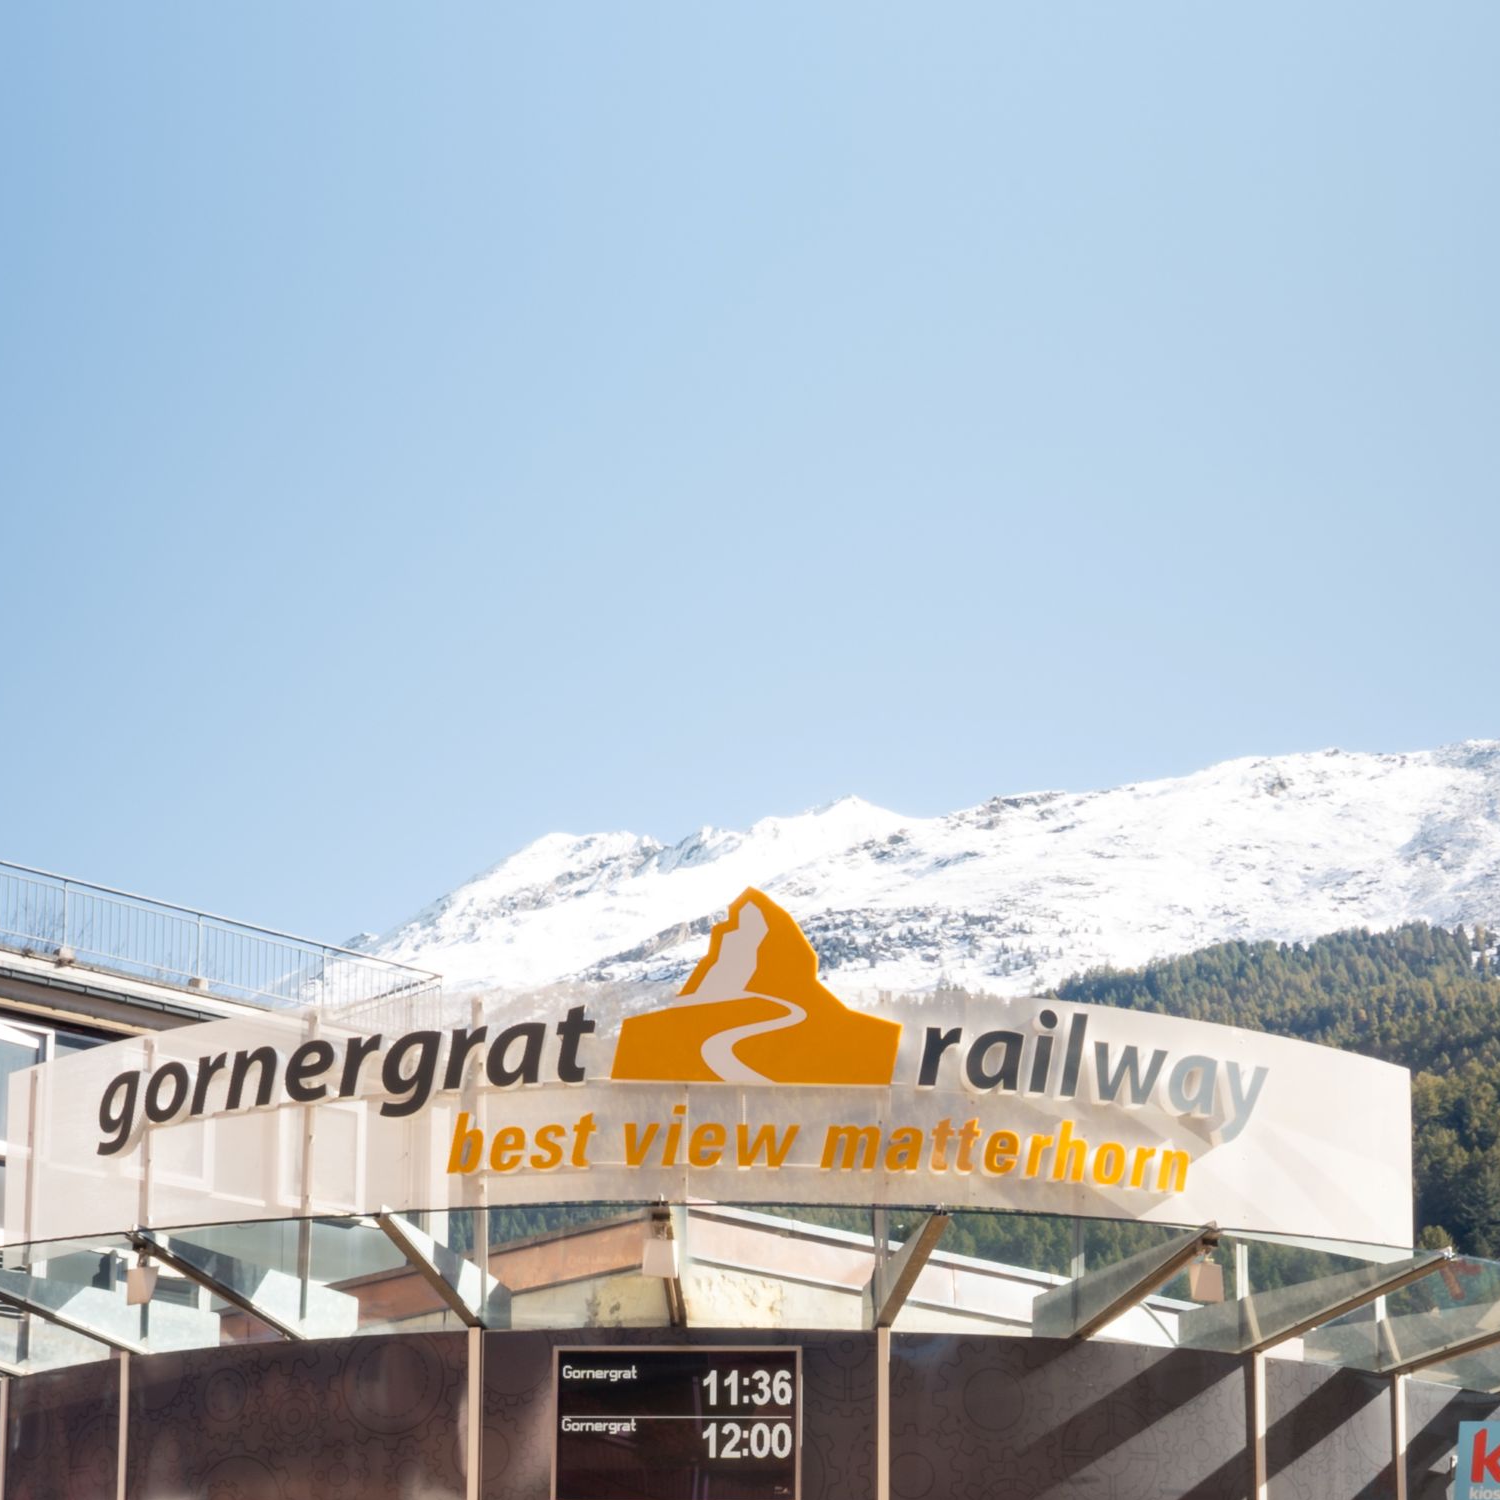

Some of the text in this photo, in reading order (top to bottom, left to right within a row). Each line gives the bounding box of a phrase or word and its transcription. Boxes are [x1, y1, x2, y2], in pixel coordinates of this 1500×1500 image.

[96, 1003, 1269, 1157] gornergrat railway
[447, 1104, 1190, 1193] best view matterhorn
[562, 1365, 793, 1406] Gornergrat 11:36
[561, 1418, 792, 1459] Gornergrat 12:00
